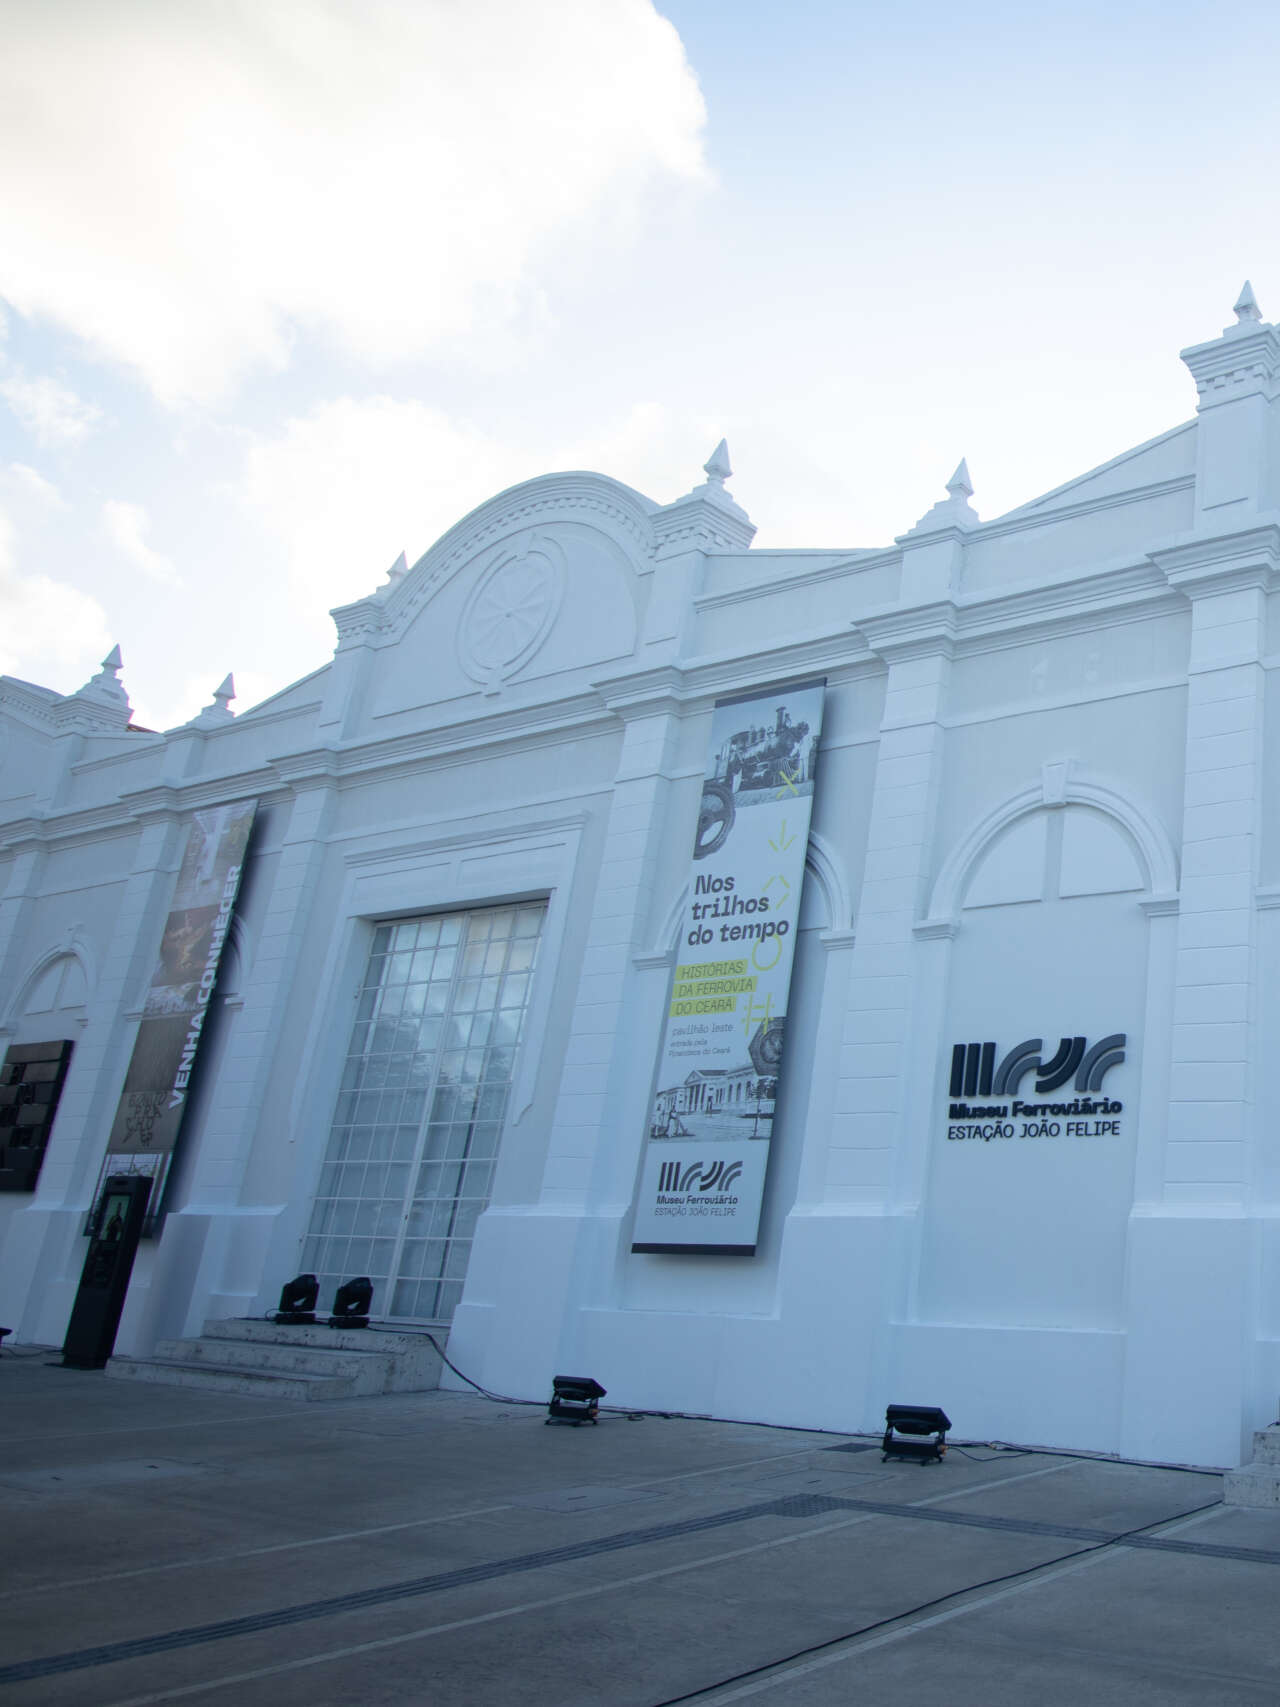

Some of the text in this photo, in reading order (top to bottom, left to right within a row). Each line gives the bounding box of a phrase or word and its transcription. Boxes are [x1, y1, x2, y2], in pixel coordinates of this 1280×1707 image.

[695, 874, 735, 895] Nos
[692, 895, 770, 920] trilhos
[688, 920, 789, 946] do tempo
[681, 961, 745, 980] HISTÓRIAS
[168, 863, 242, 1110] VENHA CONHECER
[678, 978, 754, 998] DA FERROVIA
[675, 1001, 692, 1016] DO
[949, 1097, 1122, 1119] Museu Ferroviário
[948, 1119, 1121, 1141] ESTAÇÃO JOÃO FELIPE
[656, 1194, 738, 1204] Museu Ferroviário
[655, 1206, 736, 1217] ESTAÇÃO JOÃO FELIPE
